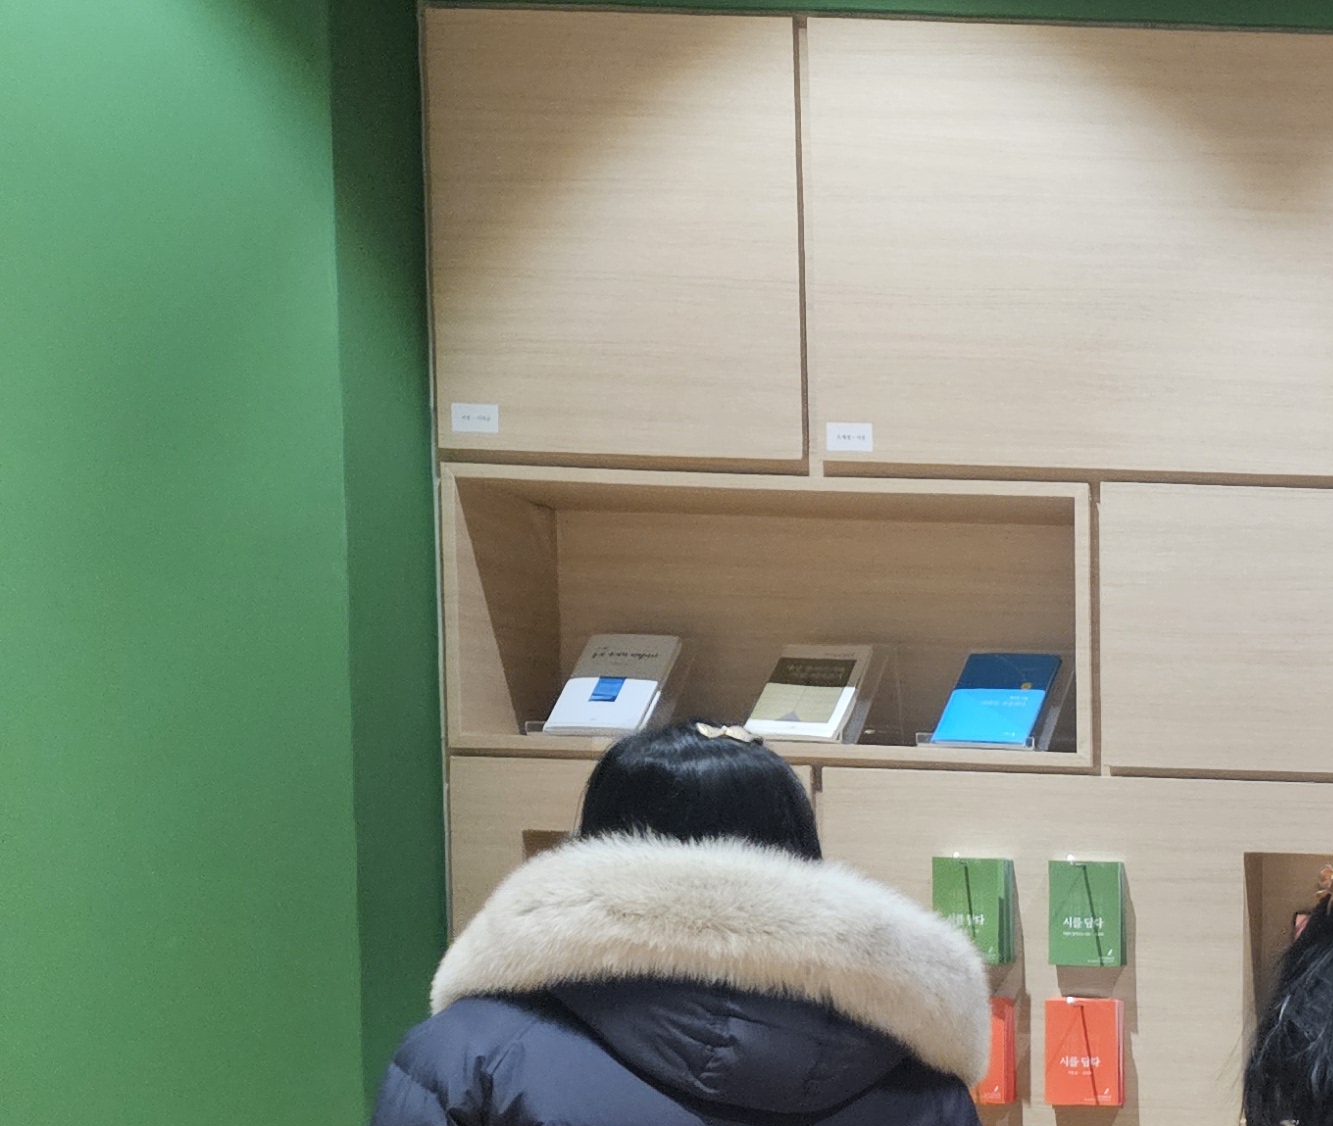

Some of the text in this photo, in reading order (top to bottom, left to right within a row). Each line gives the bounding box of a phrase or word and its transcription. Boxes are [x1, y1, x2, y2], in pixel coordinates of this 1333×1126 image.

[1063, 916, 1104, 929] 시를 담다
[1060, 1055, 1101, 1068] 시를 담다
